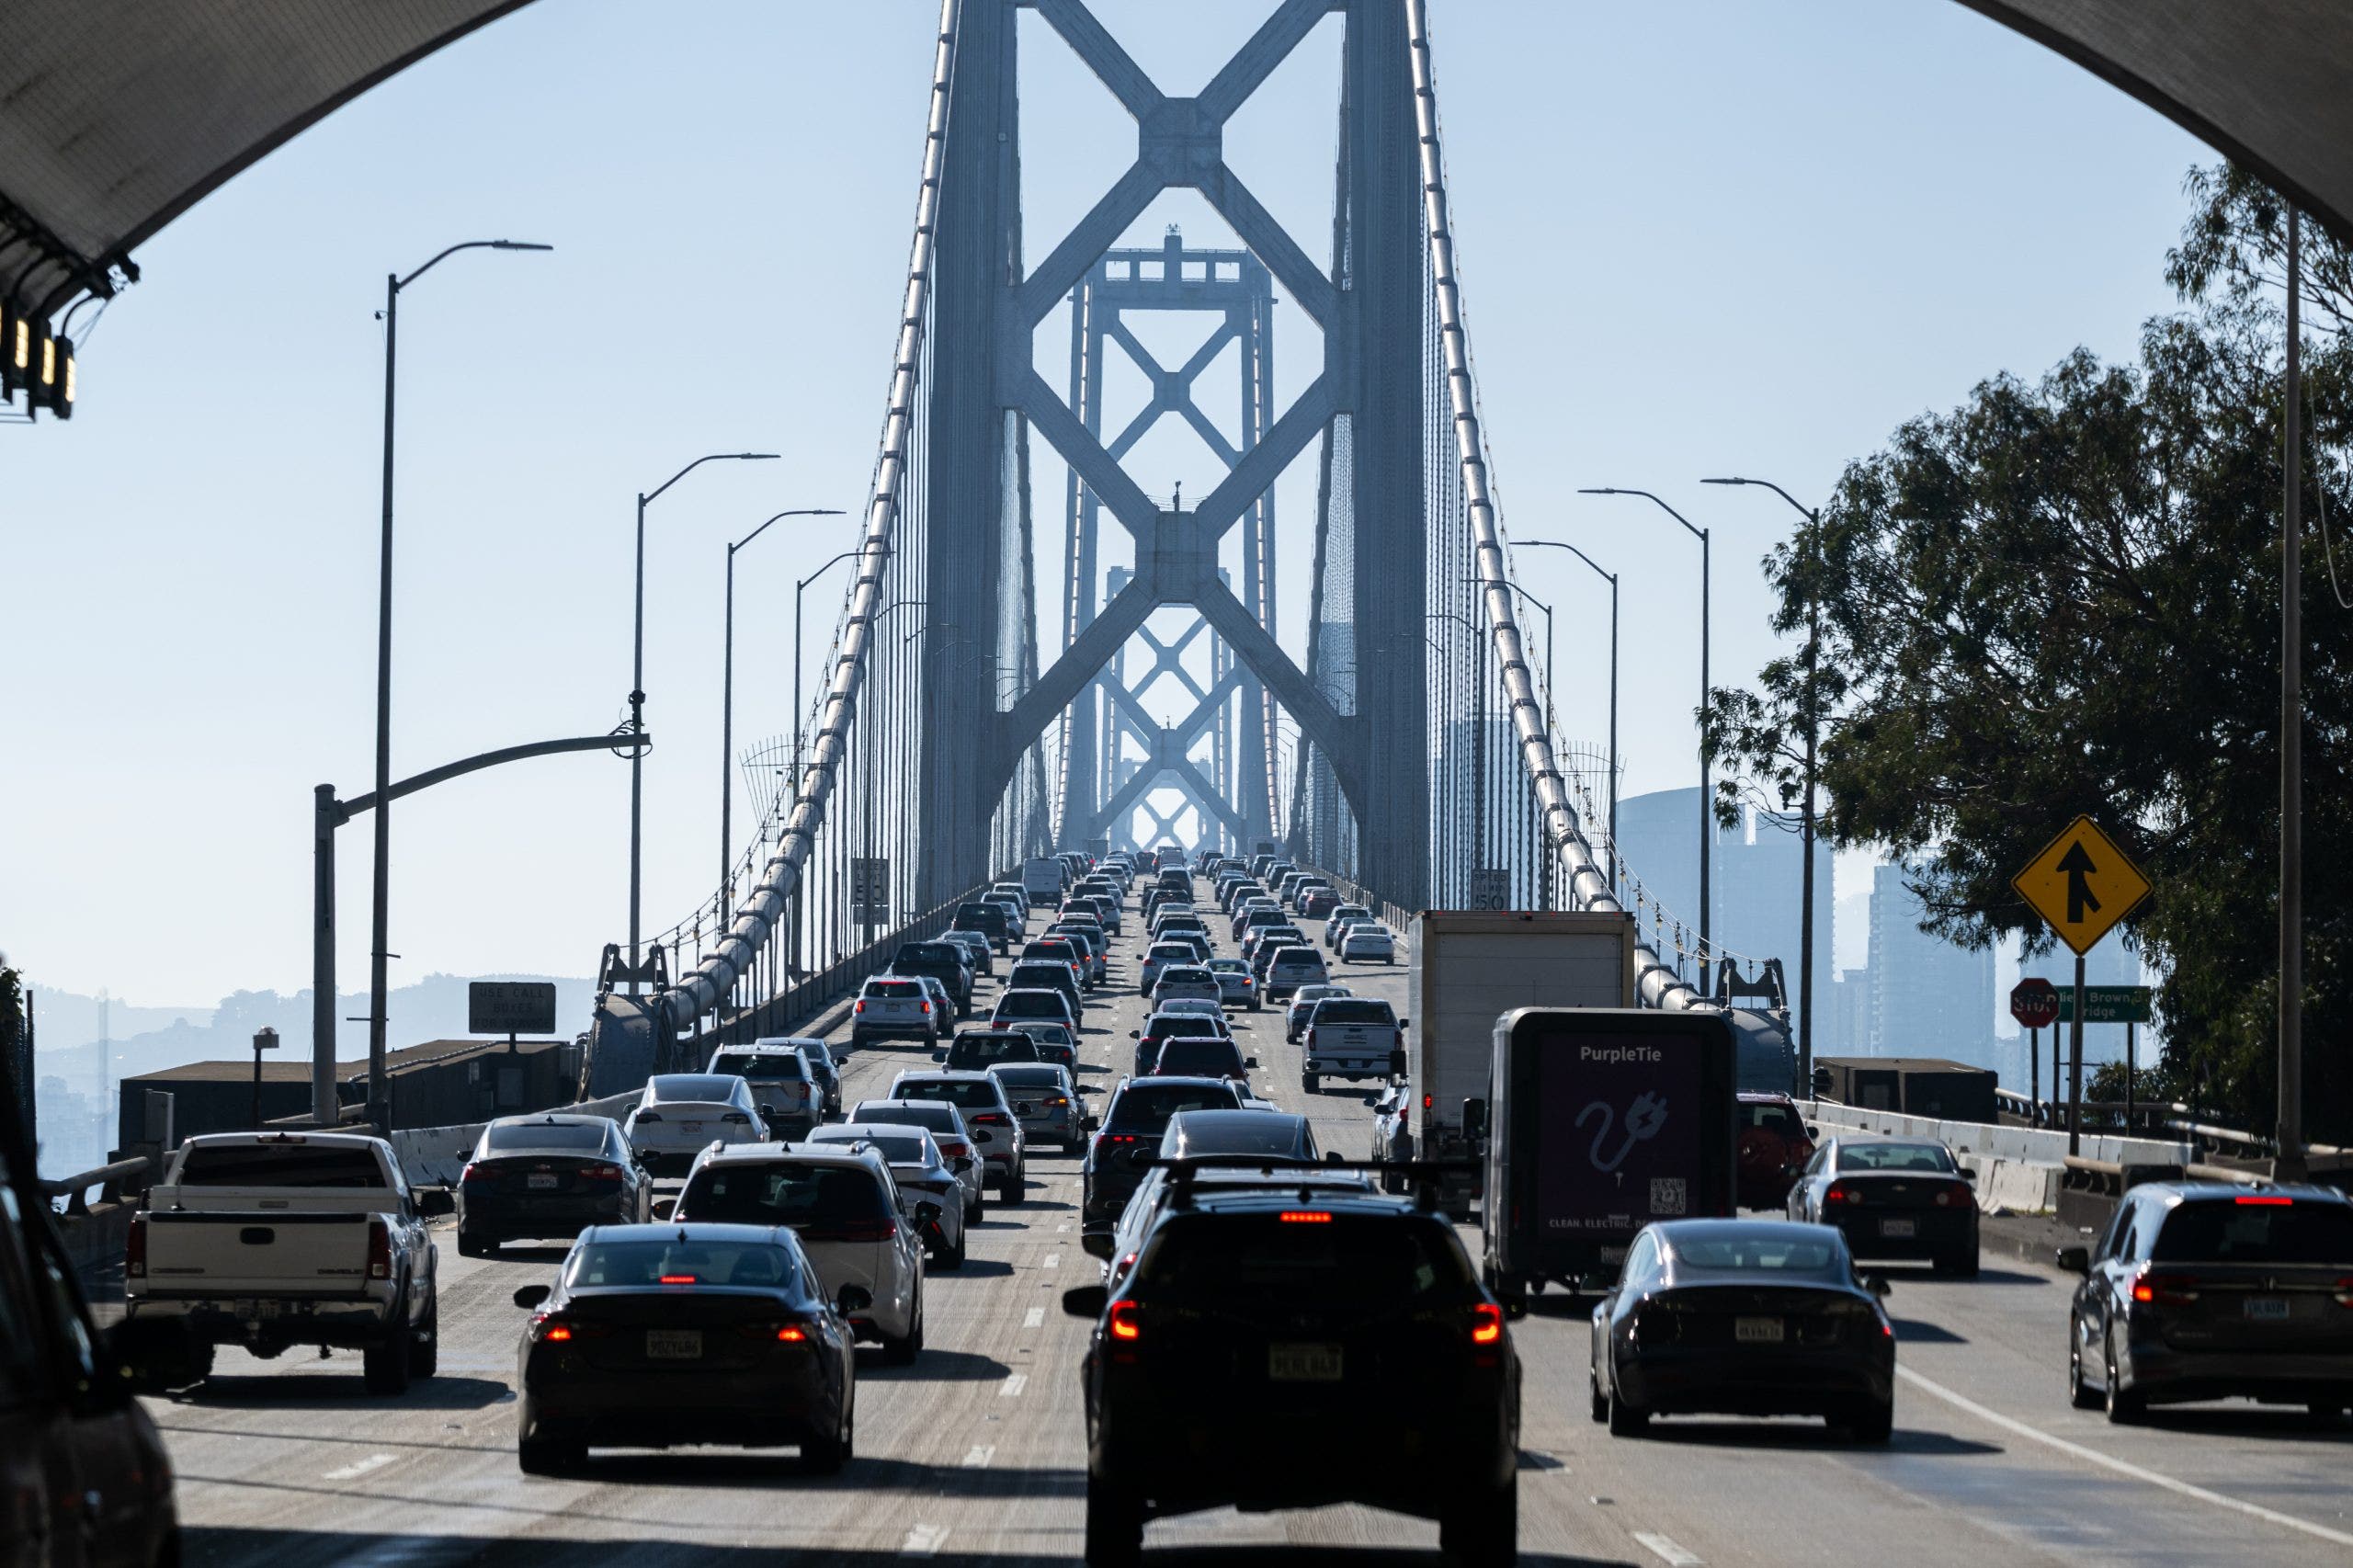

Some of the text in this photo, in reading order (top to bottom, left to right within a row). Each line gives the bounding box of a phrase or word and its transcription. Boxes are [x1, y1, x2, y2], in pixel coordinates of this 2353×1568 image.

[1475, 894, 1504, 911] 50
[479, 988, 544, 998] USE CALL
[2089, 993, 2130, 1004] Brown
[2083, 1006, 2116, 1019] ridge
[1580, 1046, 1662, 1064] PurpleTie
